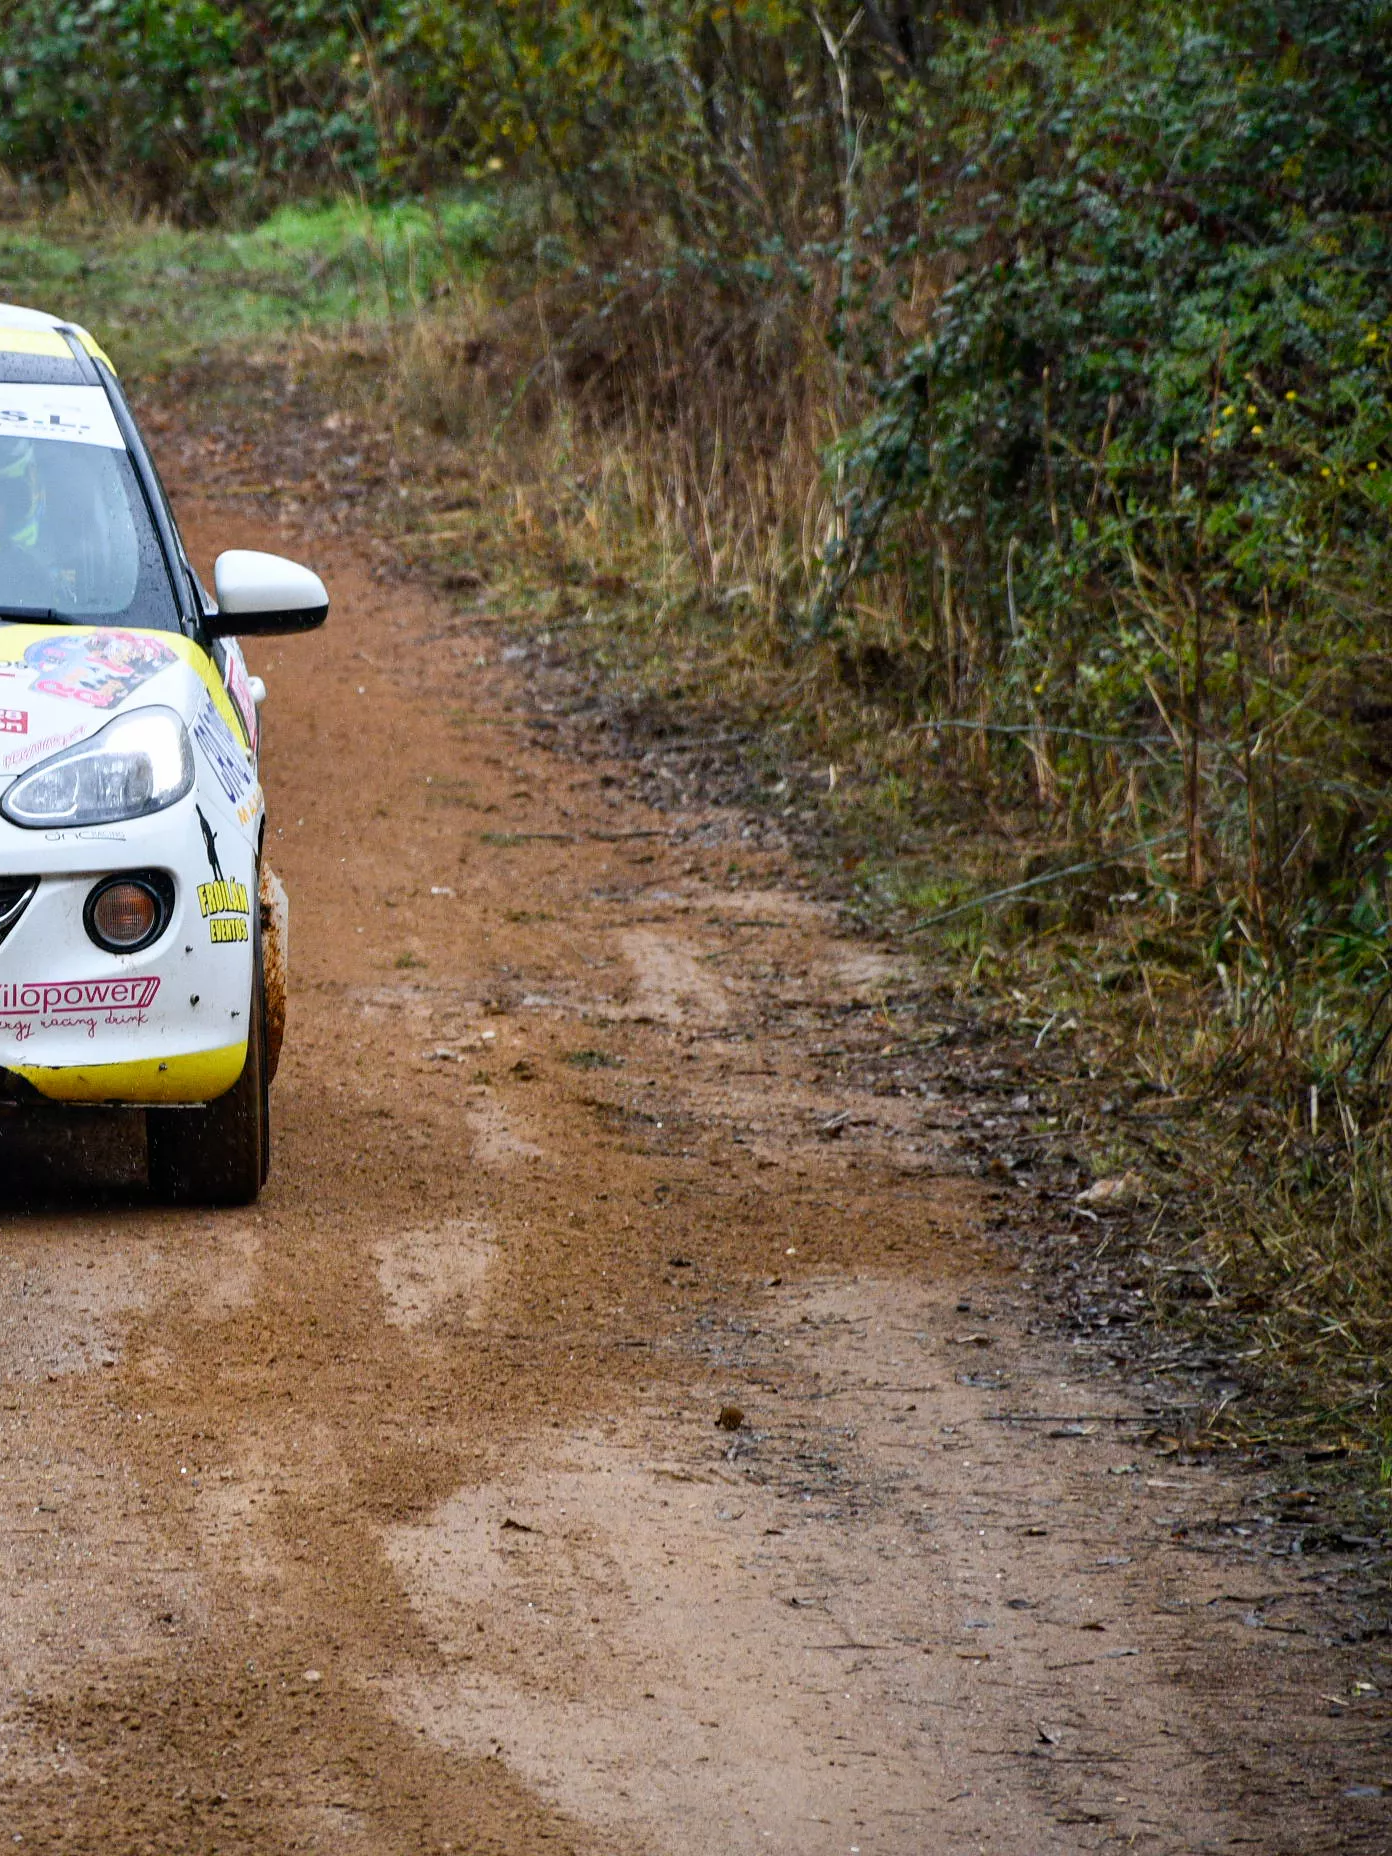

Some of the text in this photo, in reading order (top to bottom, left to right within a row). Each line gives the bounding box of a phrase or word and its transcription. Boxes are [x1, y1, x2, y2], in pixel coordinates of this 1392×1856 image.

[197, 876, 250, 918] FROILÁN
[210, 918, 249, 943] EVENTOS
[40, 1016, 98, 1039] racing
[105, 1007, 149, 1028] drink
